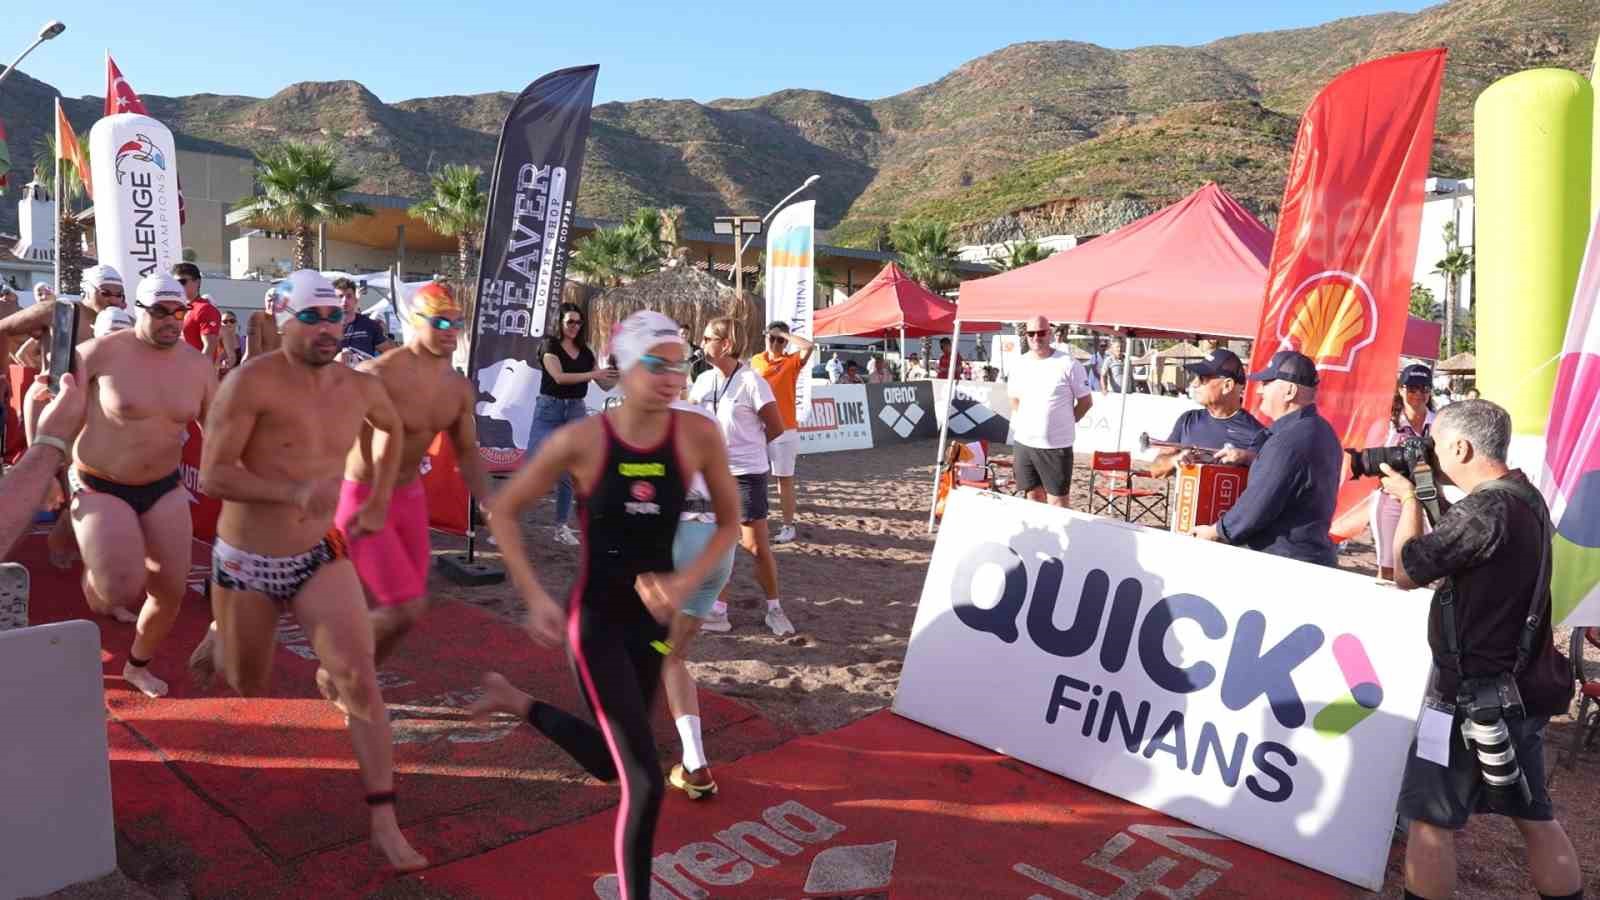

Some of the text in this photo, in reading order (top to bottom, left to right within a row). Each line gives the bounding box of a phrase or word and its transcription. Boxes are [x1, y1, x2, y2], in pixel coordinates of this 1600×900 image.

[500, 163, 551, 337] BEAVER
[537, 197, 562, 307] COFFEE SHOP
[559, 200, 573, 243] COFFEE
[477, 278, 504, 335] THE
[884, 386, 917, 404] arena
[951, 541, 1326, 729] QUICK
